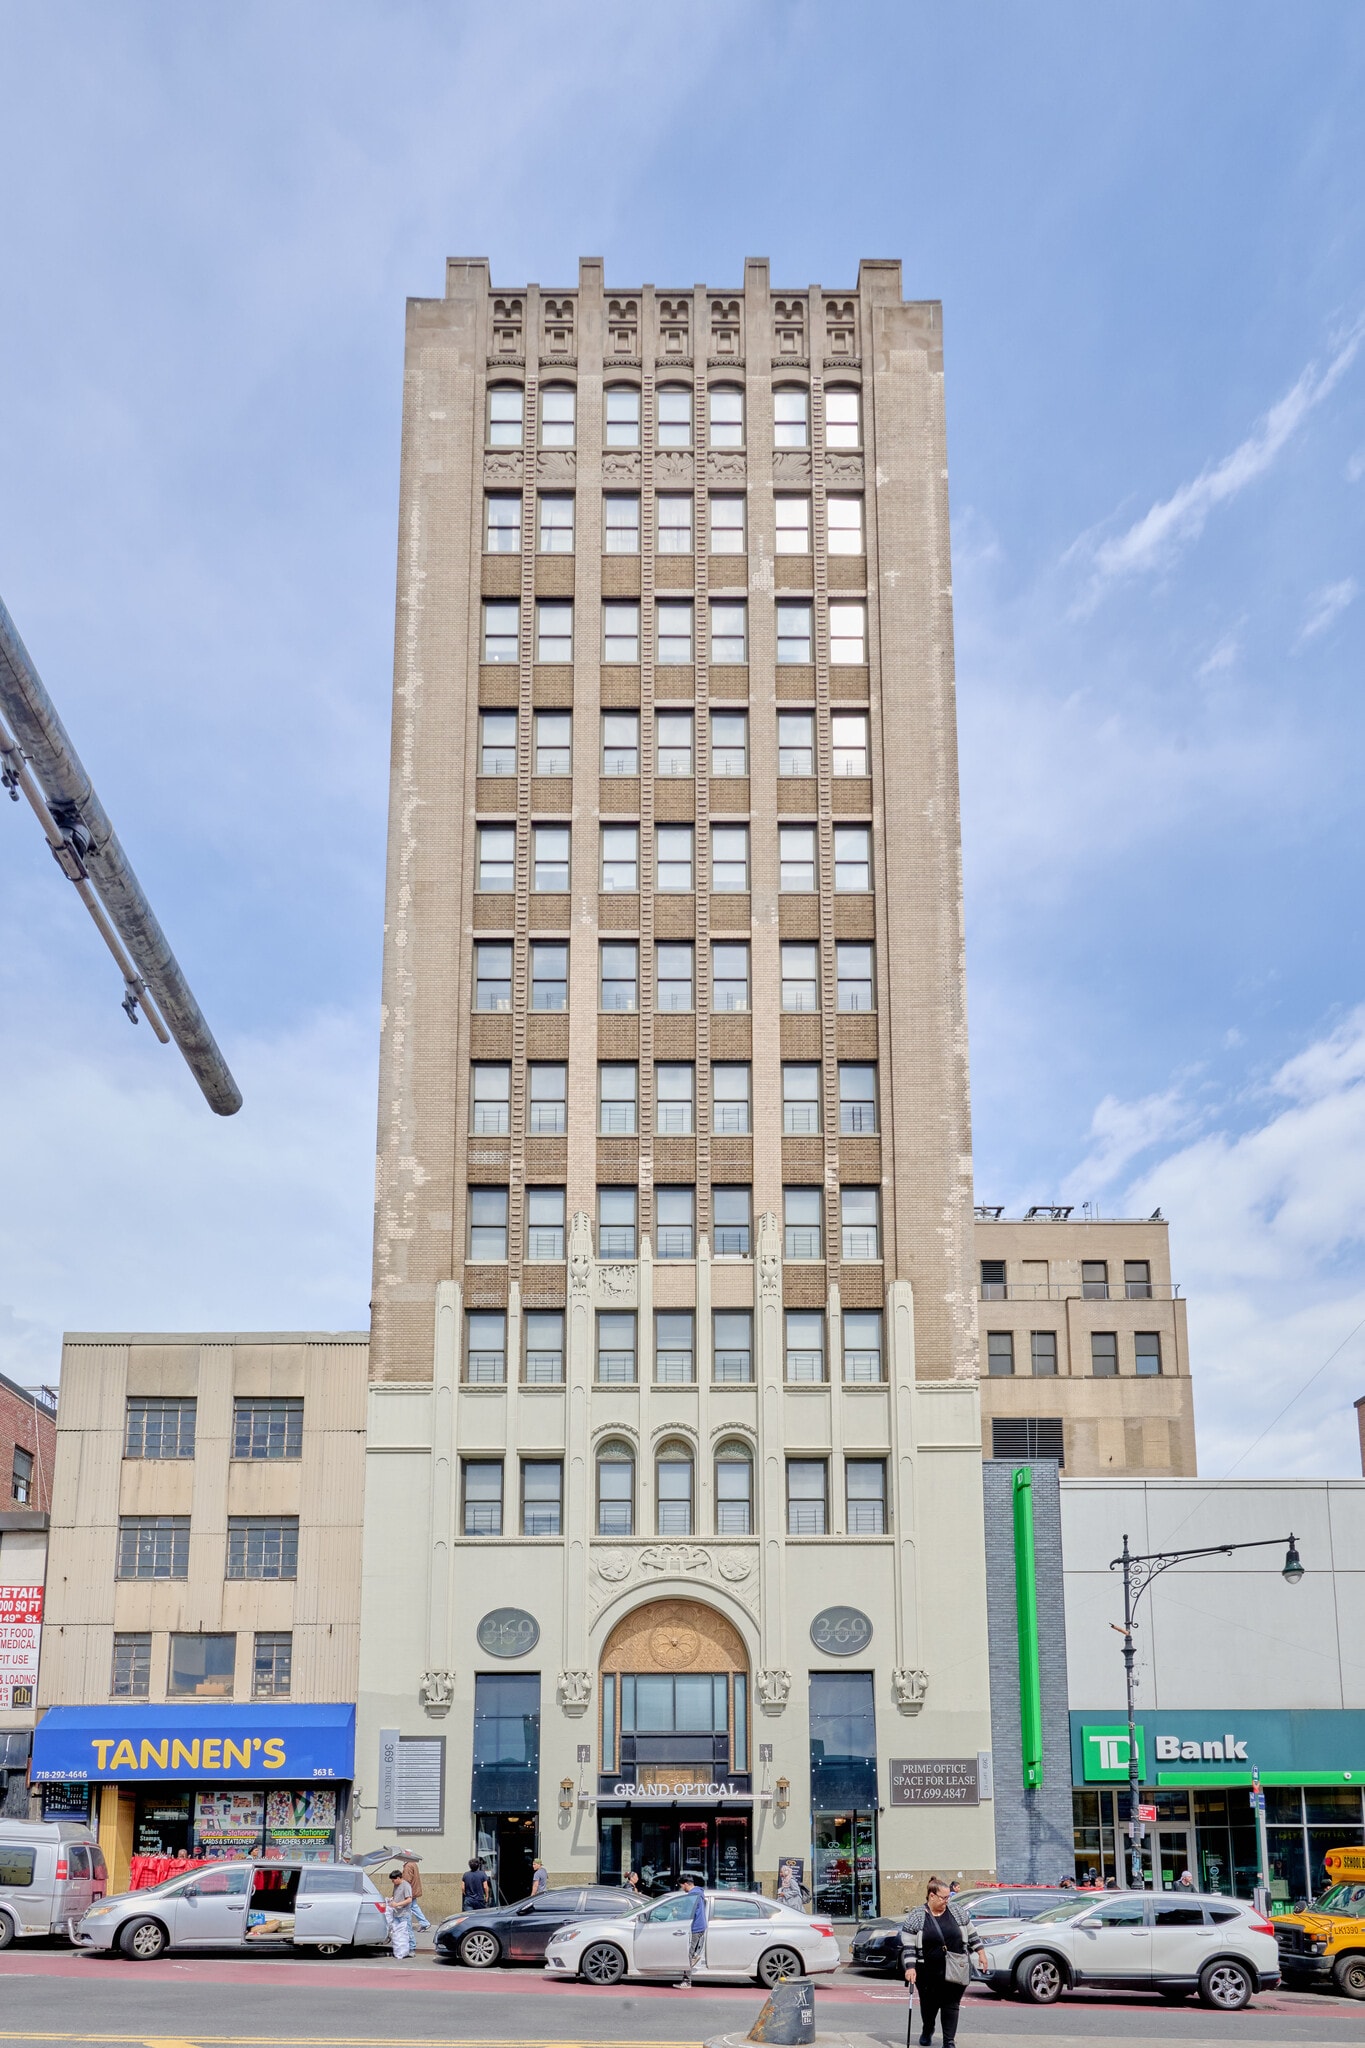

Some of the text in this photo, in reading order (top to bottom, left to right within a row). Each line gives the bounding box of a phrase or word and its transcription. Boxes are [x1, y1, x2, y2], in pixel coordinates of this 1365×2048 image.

[15, 1600, 27, 1612] SQ
[29, 1600, 40, 1612] FT
[24, 1614, 39, 1623] St.
[10, 1628, 35, 1639] FOOD,
[817, 1618, 867, 1643] 369
[1, 1639, 36, 1649] MEDICAL
[12, 1654, 29, 1665] USE
[5, 1674, 36, 1685] LOADING
[91, 1737, 286, 1770] TANNEN'S
[1089, 1734, 1249, 1769] TD Bank
[902, 1764, 967, 1774] PRIME OFFICE
[36, 1771, 88, 1779] 718-292-4646
[384, 1744, 394, 1811] 369 DIRECTORY
[893, 1775, 924, 1785] SPACE
[925, 1775, 945, 1785] FOR
[946, 1775, 976, 1785] LEASE
[614, 1783, 739, 1797] GRAND OPTICAL
[903, 1788, 967, 1799] 917.699.4847
[299, 1828, 331, 1837] Stationers
[1344, 1856, 1361, 1868] SCHOOL
[1334, 1926, 1359, 1935] LK1390
